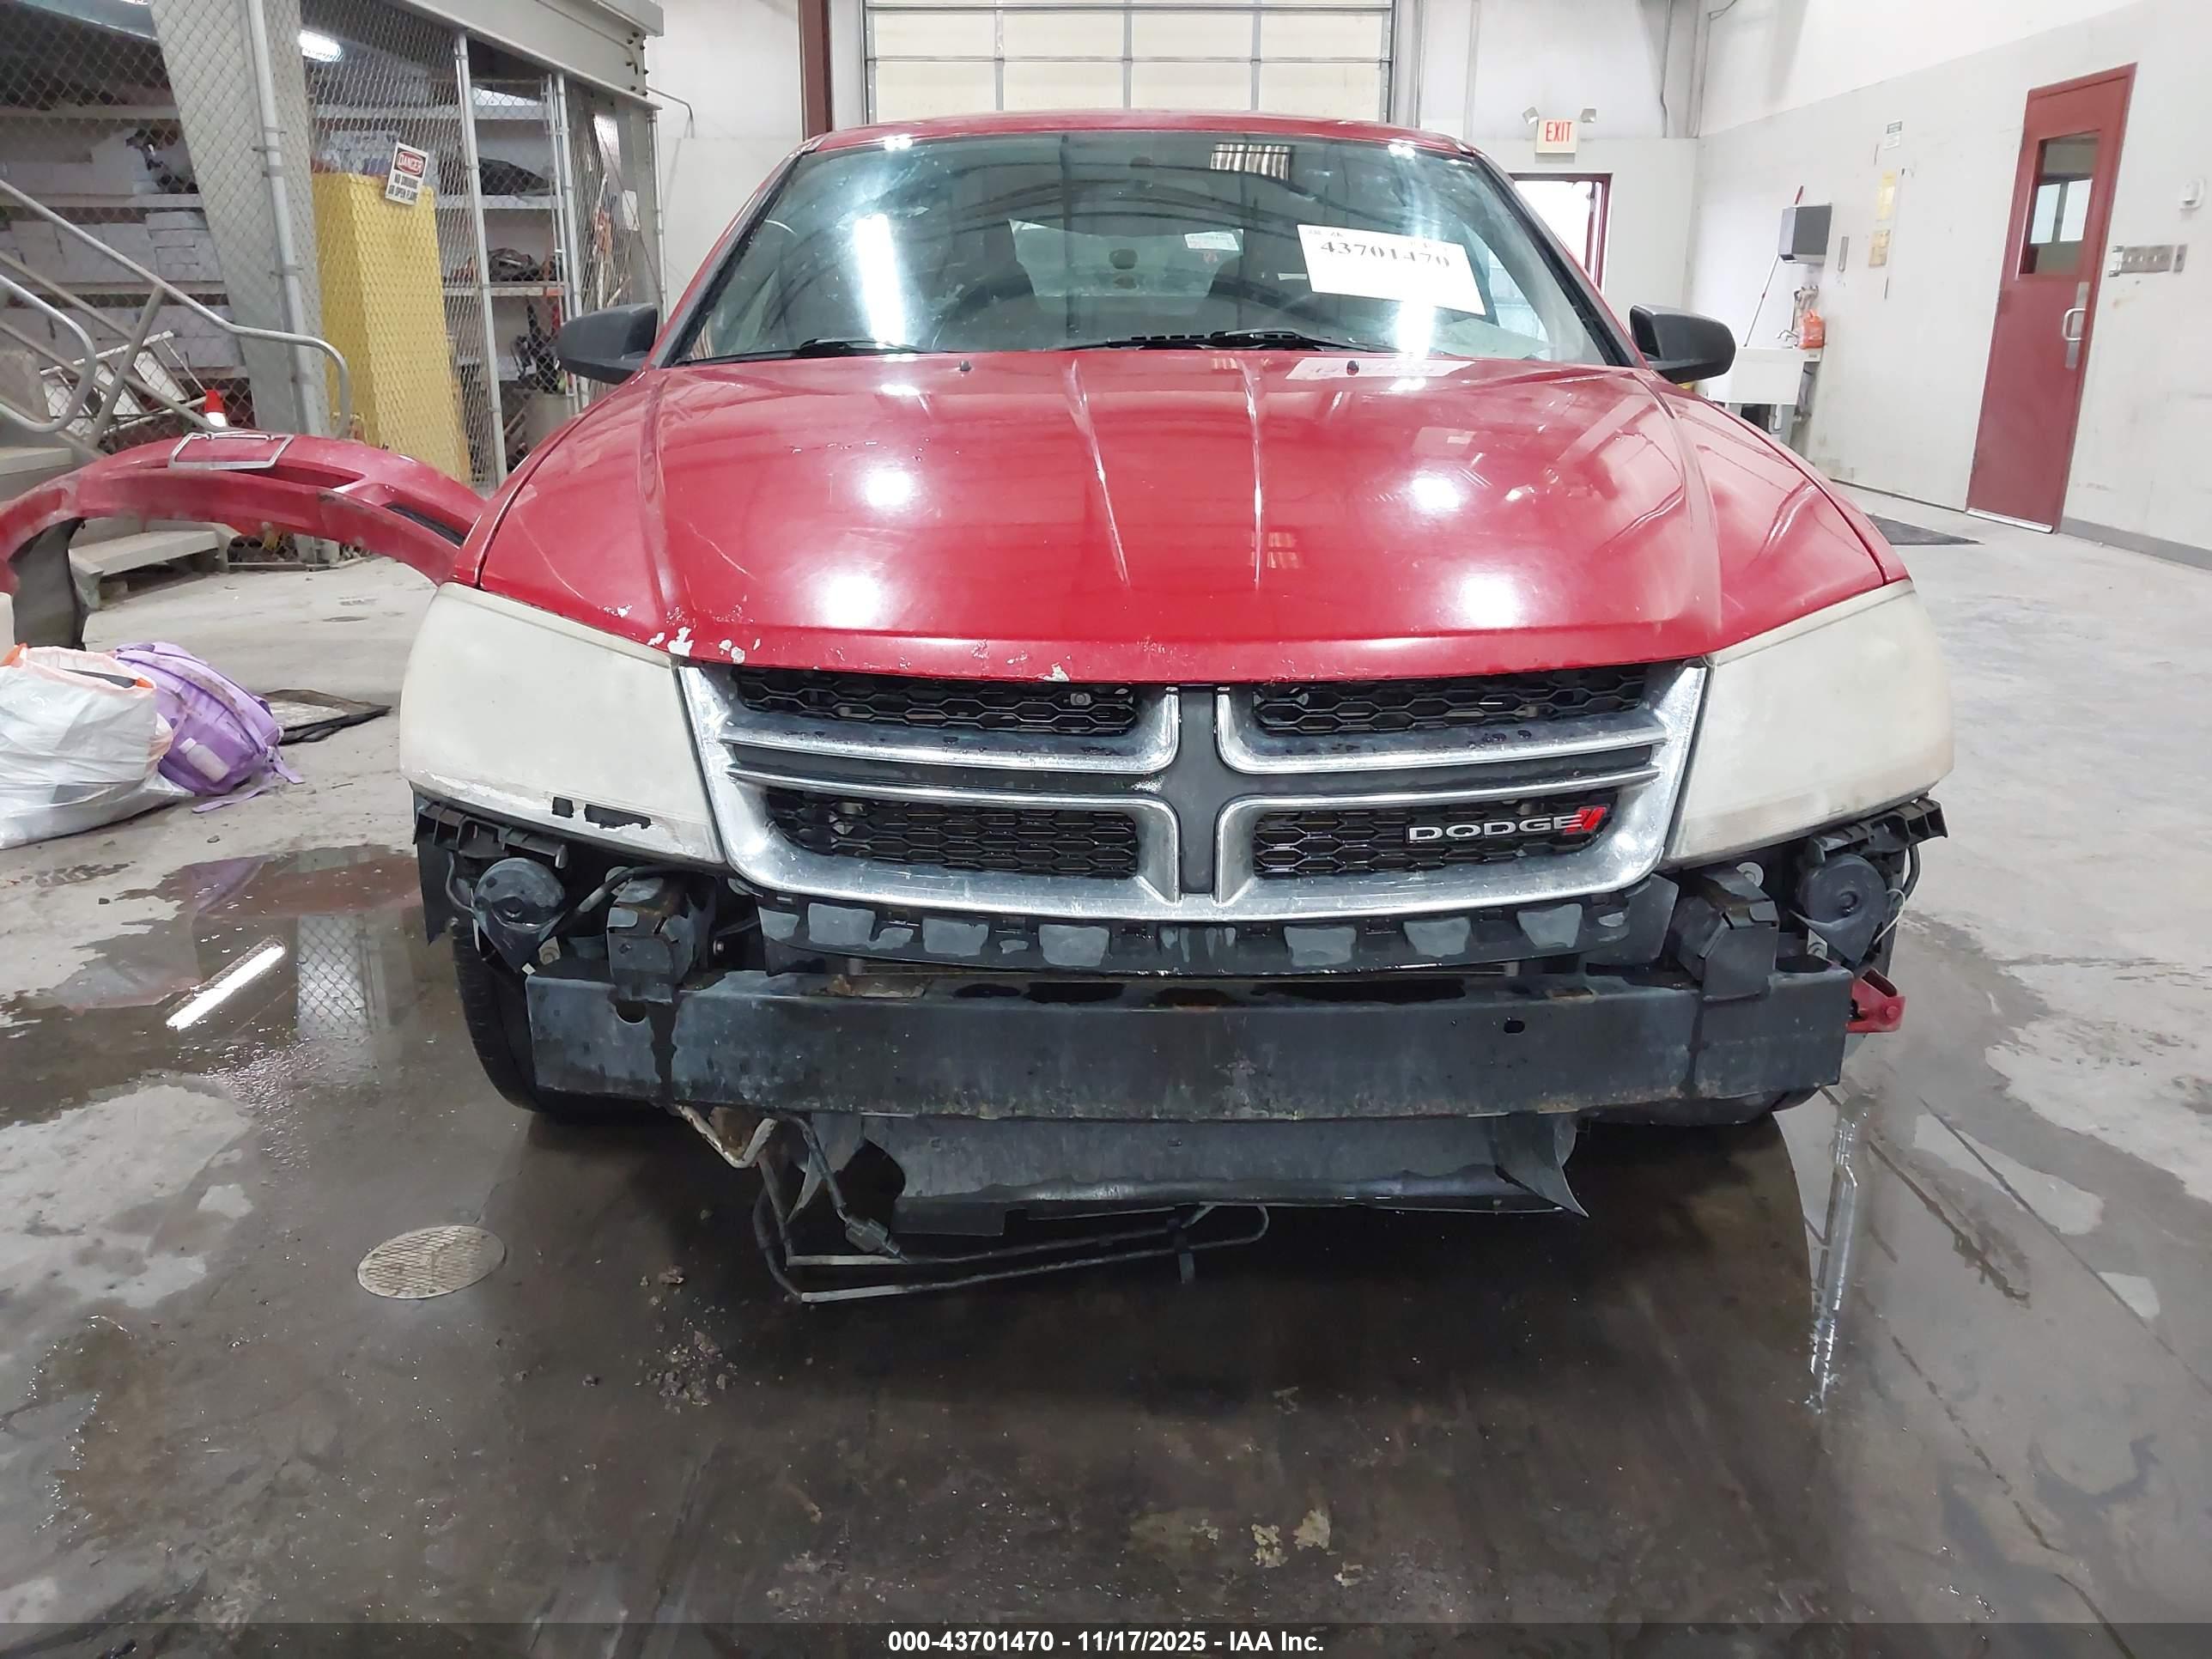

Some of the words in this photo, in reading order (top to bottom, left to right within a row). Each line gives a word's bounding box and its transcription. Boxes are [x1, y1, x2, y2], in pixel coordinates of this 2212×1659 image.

[1545, 121, 1572, 143] EXIT
[398, 155, 422, 171] DANGER
[1320, 241, 1450, 268] 43701470
[1407, 814, 1583, 842] DODGE
